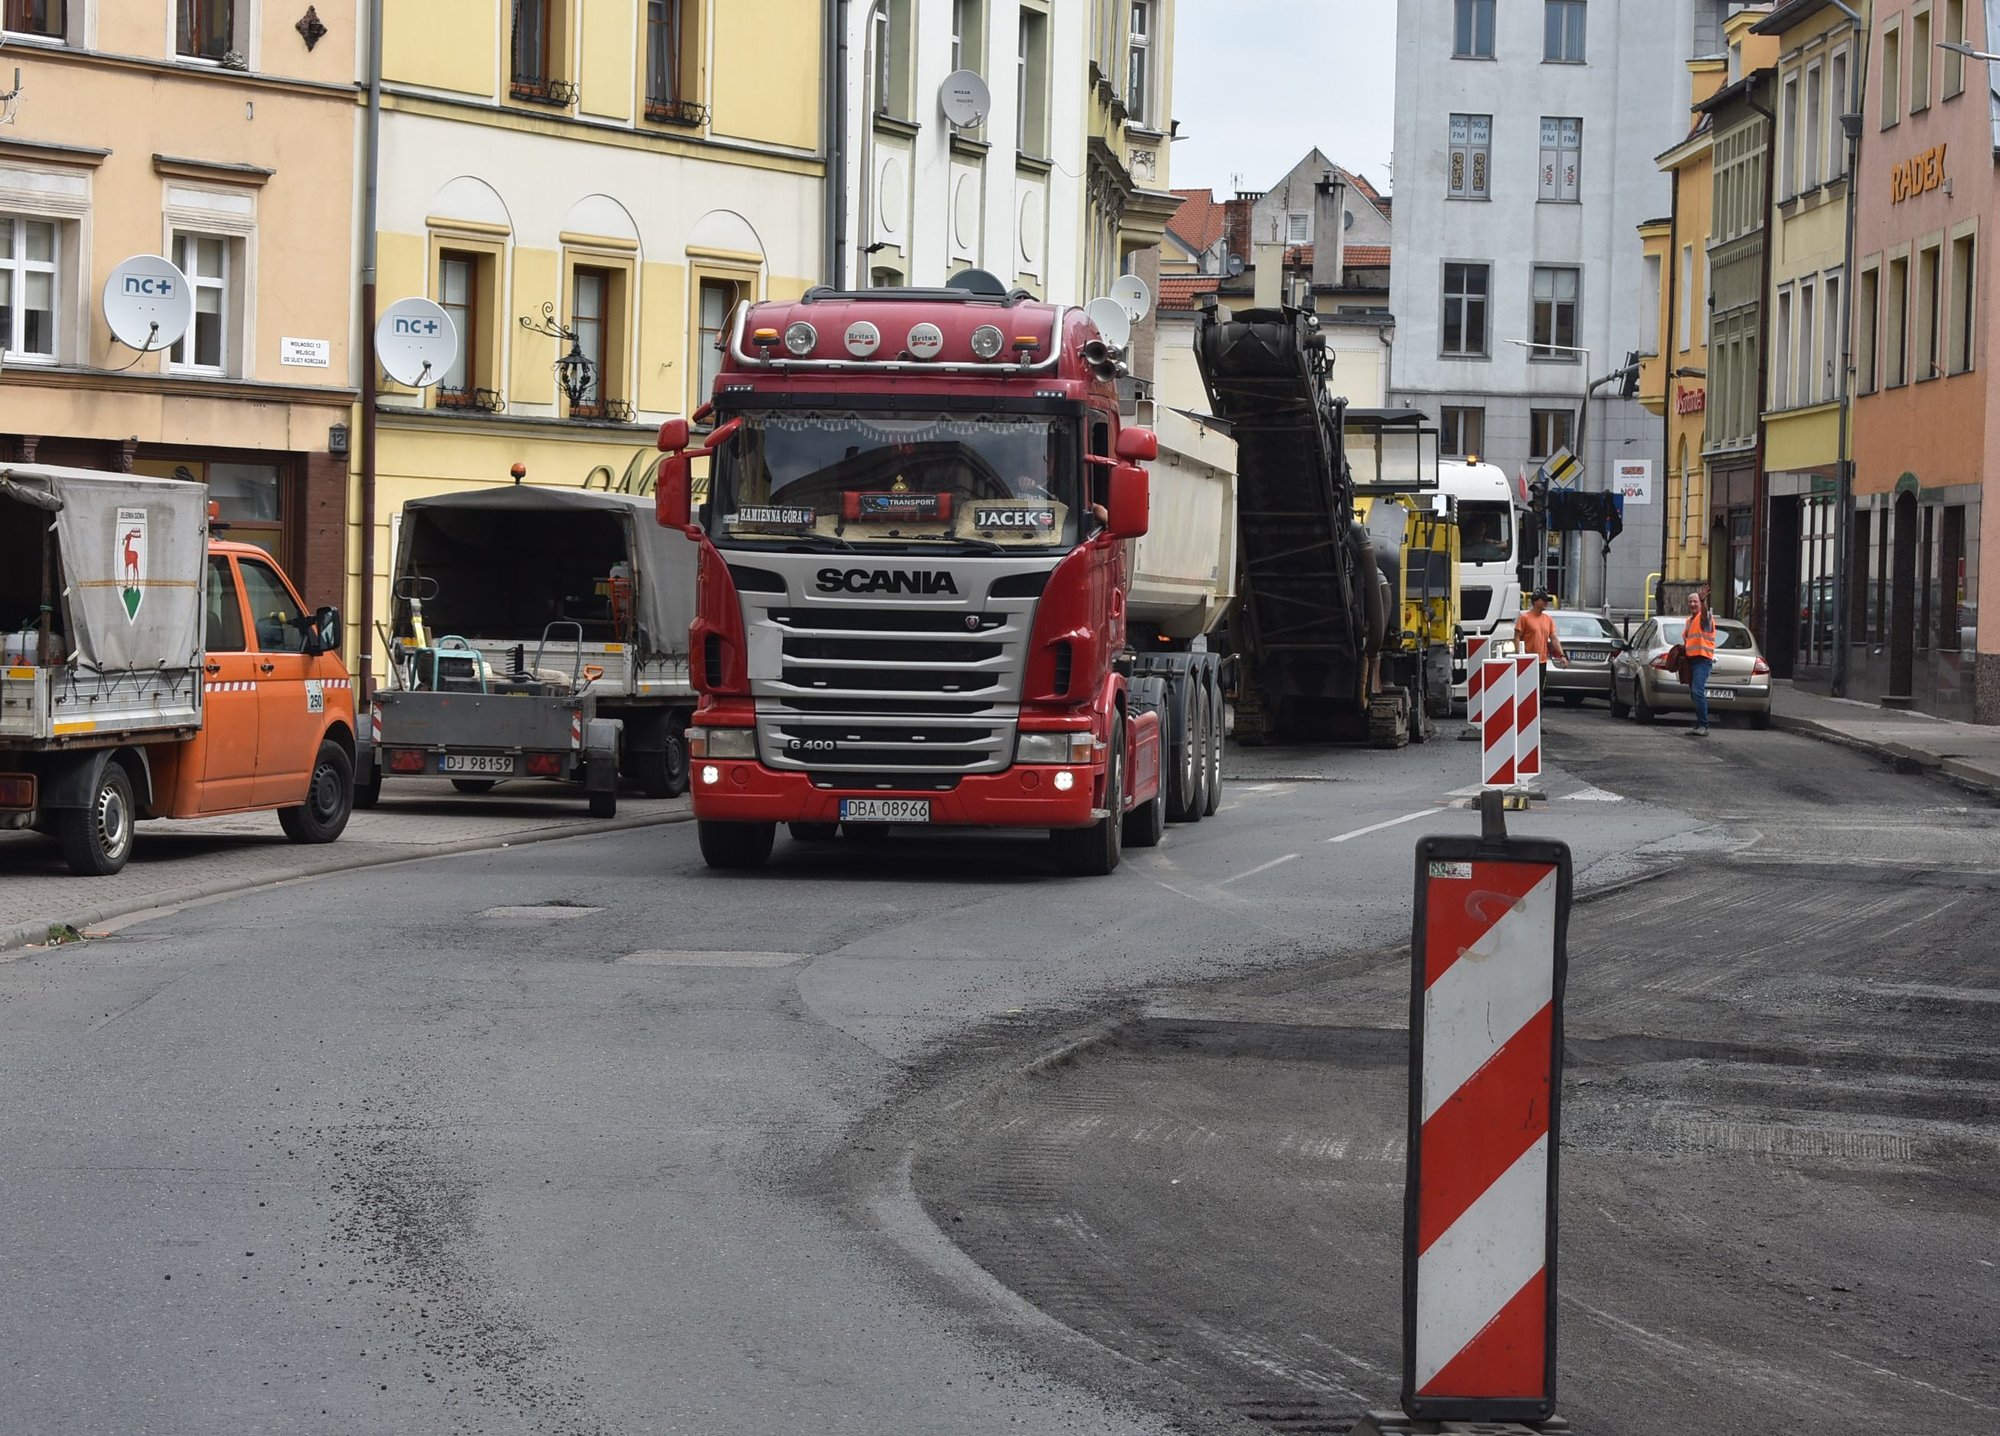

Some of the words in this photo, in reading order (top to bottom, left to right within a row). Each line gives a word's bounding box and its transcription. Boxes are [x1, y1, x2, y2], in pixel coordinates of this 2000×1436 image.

[1452, 131, 1465, 139] FM
[1473, 132, 1487, 140] FM
[1563, 135, 1576, 143] FM
[1891, 143, 1947, 205] RADEX
[125, 277, 172, 295] nc+
[395, 318, 438, 334] nc+
[848, 332, 875, 340] Britax
[911, 334, 938, 342] Britax
[332, 433, 345, 447] 12
[740, 508, 781, 522] KAMIENNA
[782, 506, 803, 524] GÓRA
[978, 511, 1039, 526] JACEK
[815, 568, 959, 595] SCANIA
[310, 694, 323, 708] 250
[790, 740, 801, 750] G
[802, 740, 834, 750] 400
[446, 756, 464, 770] DJ
[470, 757, 512, 771] 98159
[848, 801, 877, 816] DBA
[881, 801, 928, 817] 08966
